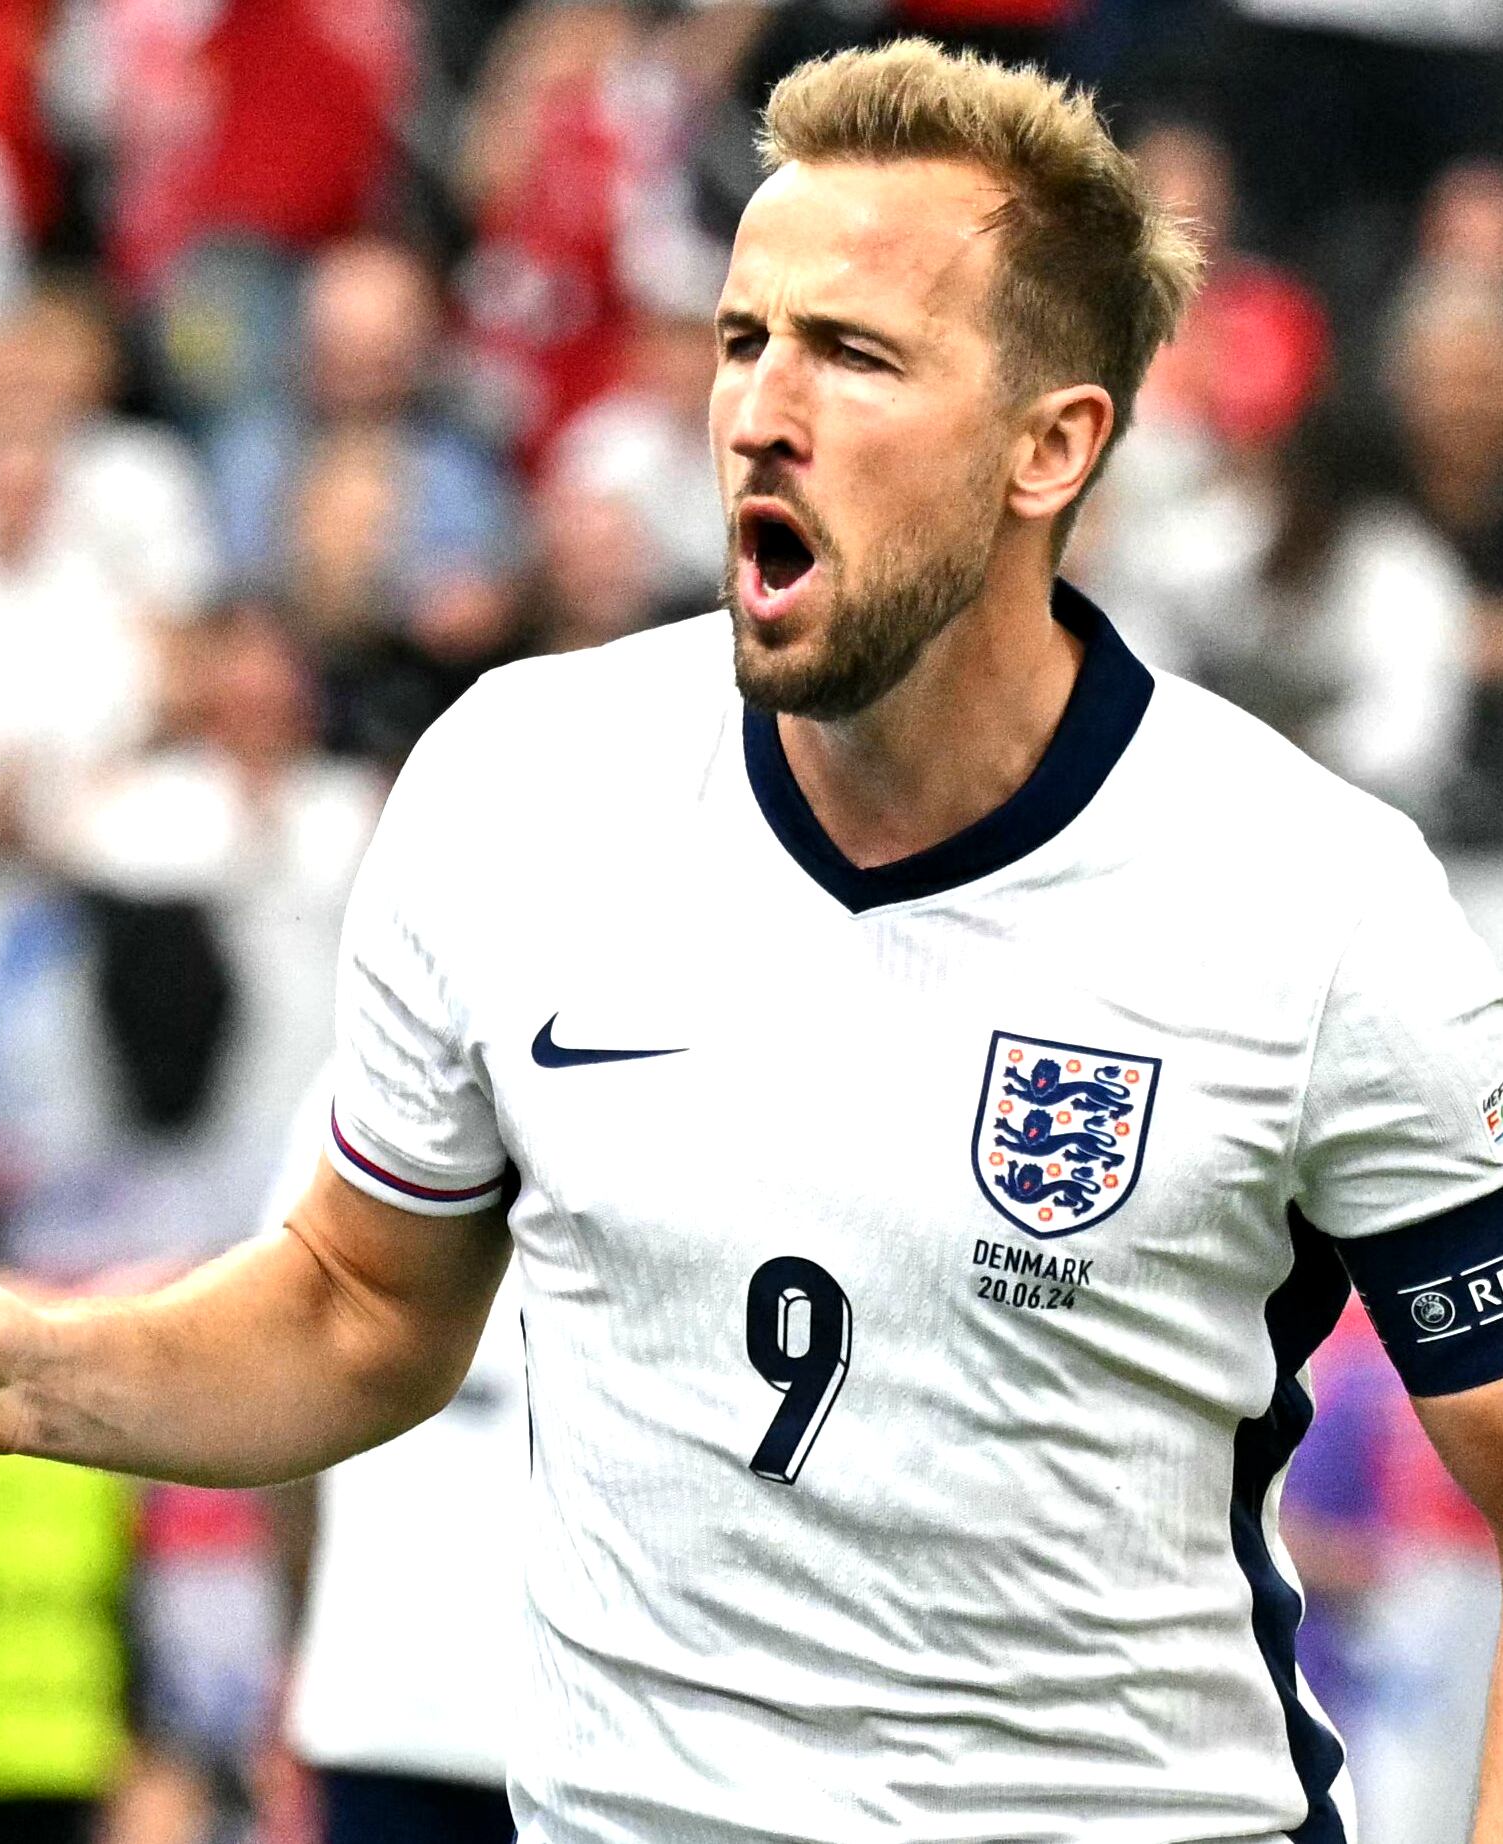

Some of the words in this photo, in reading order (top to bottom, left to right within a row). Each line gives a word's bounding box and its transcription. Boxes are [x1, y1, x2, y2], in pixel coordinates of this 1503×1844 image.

[973, 1239, 1093, 1286] DENMARK
[977, 1275, 1075, 1310] 20.06.24
[746, 1256, 852, 1485] 9
